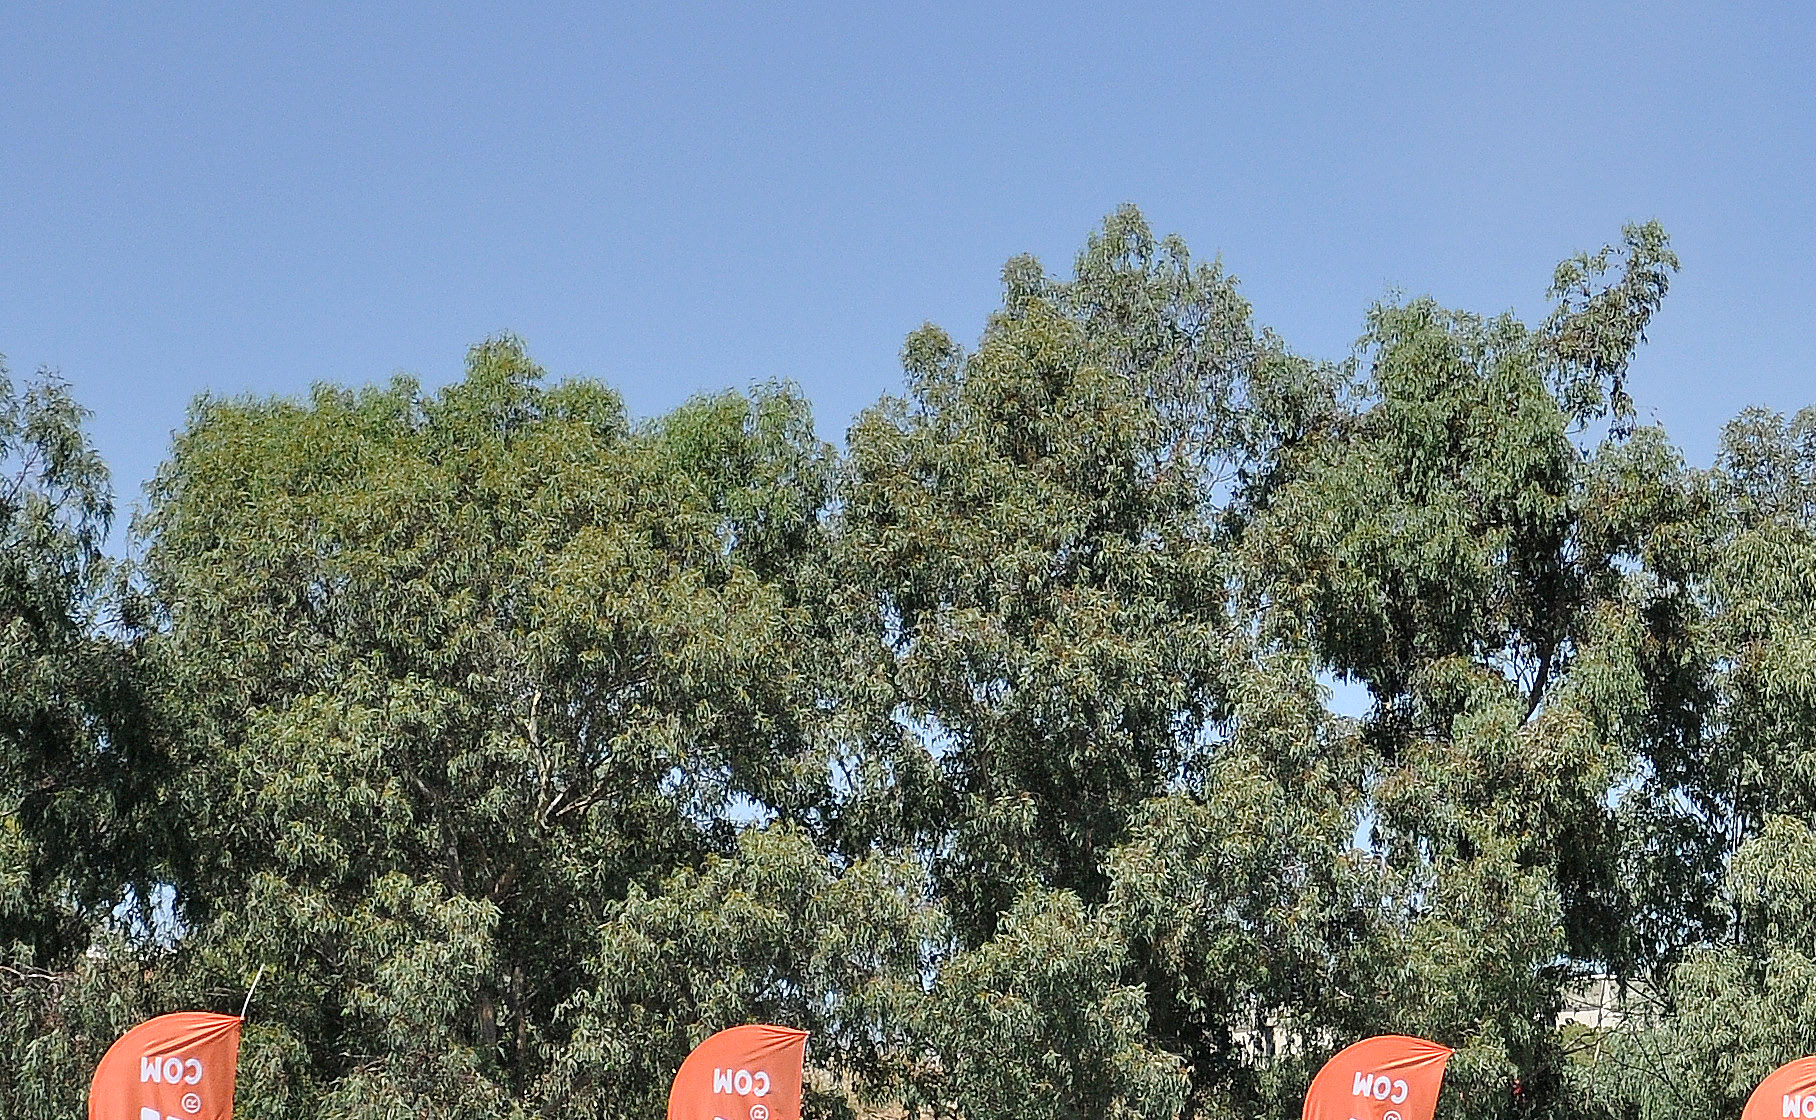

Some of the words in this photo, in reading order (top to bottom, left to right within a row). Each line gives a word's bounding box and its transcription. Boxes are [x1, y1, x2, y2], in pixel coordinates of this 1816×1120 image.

[141, 1056, 202, 1085] COM
[714, 1068, 770, 1097] COM
[1353, 1071, 1408, 1104] COM
